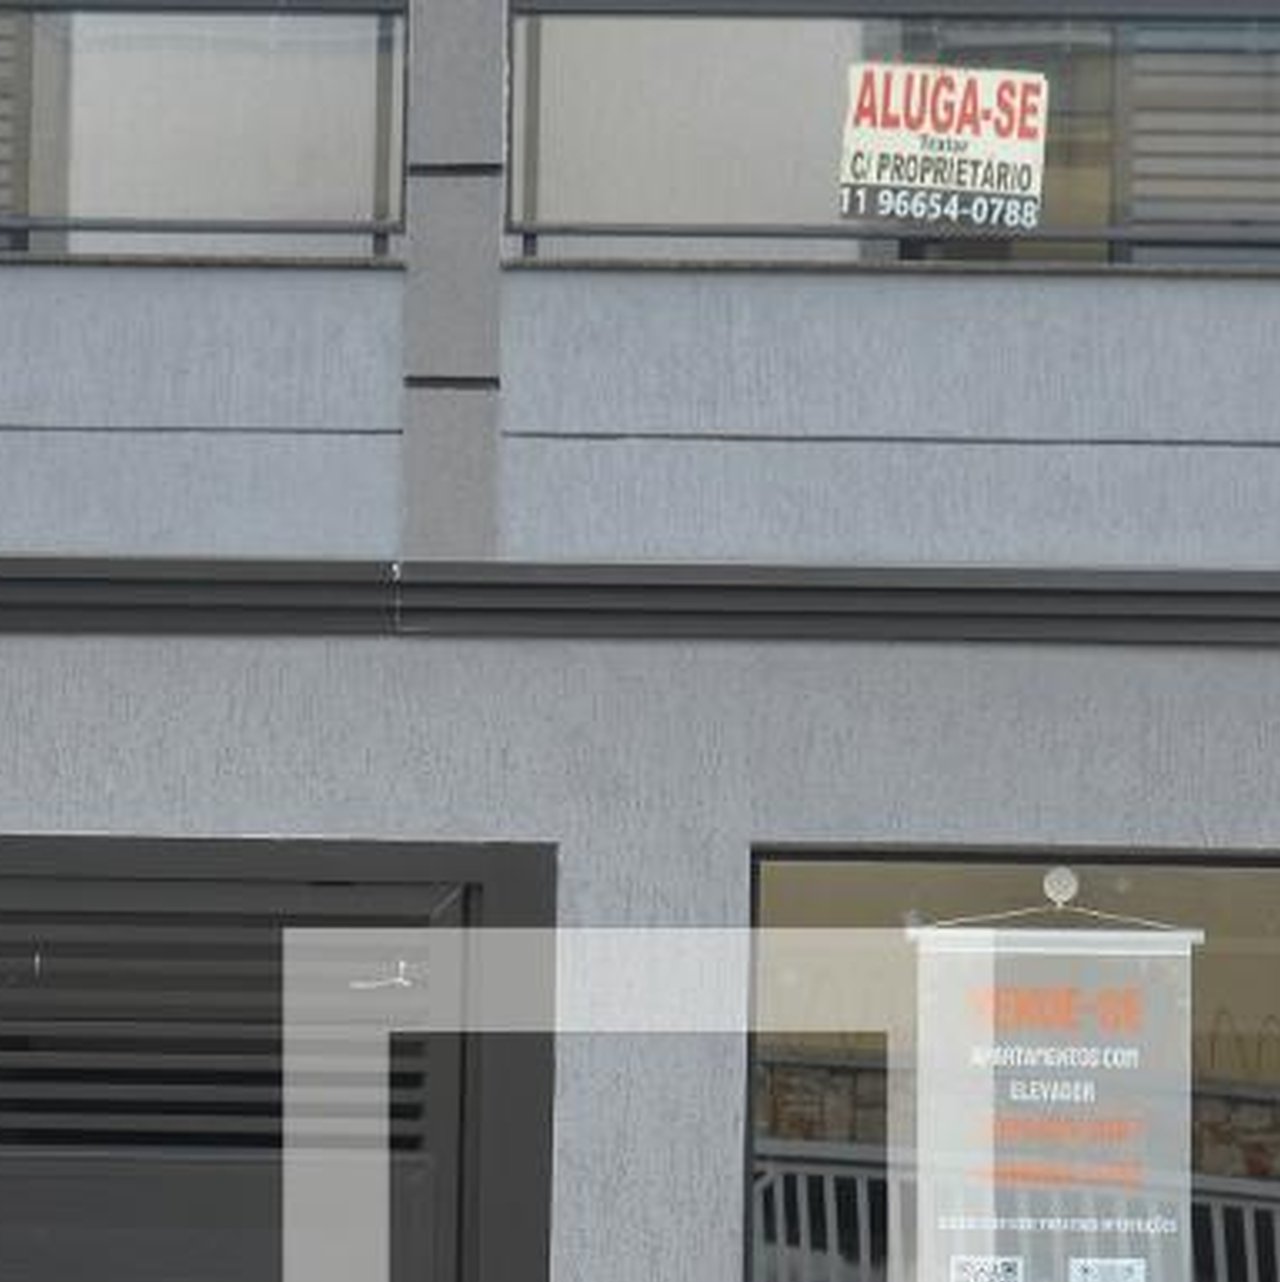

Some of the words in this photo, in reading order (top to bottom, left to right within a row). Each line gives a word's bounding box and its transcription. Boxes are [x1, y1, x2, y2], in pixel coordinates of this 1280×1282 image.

[853, 68, 1042, 140] ALUGA-SE
[841, 186, 867, 214] 11
[877, 189, 1038, 229] 96654-0788
